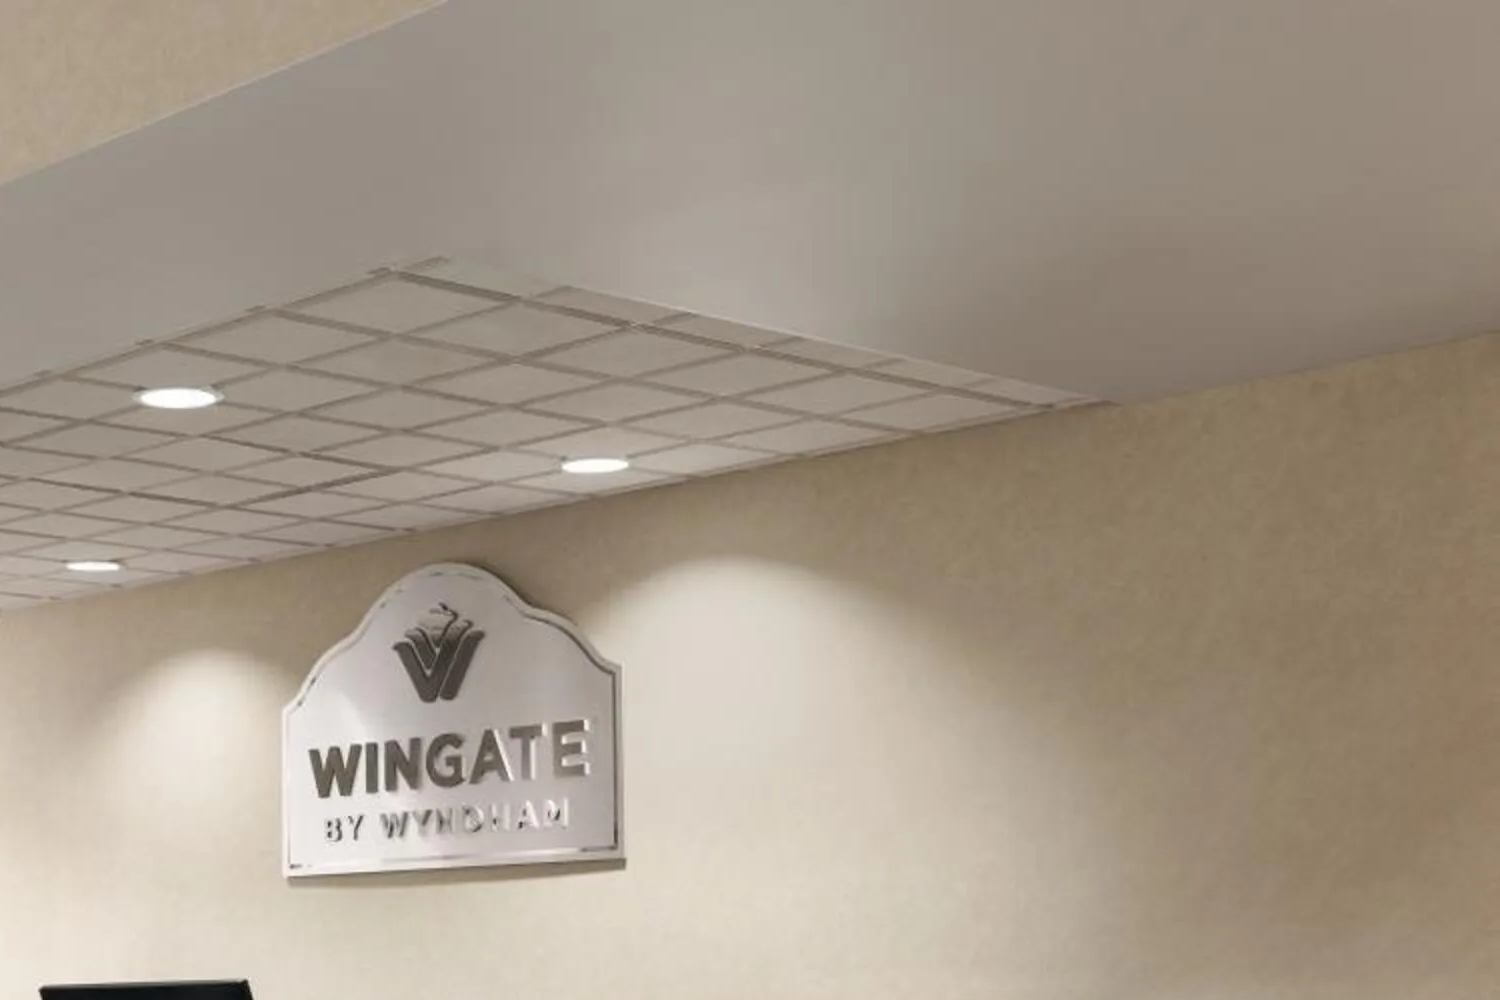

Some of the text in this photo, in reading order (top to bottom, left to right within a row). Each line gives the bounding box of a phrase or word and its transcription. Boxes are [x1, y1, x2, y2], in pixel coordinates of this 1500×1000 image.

[308, 719, 590, 799] WINGATE
[325, 797, 569, 842] BY WYNDHAM
